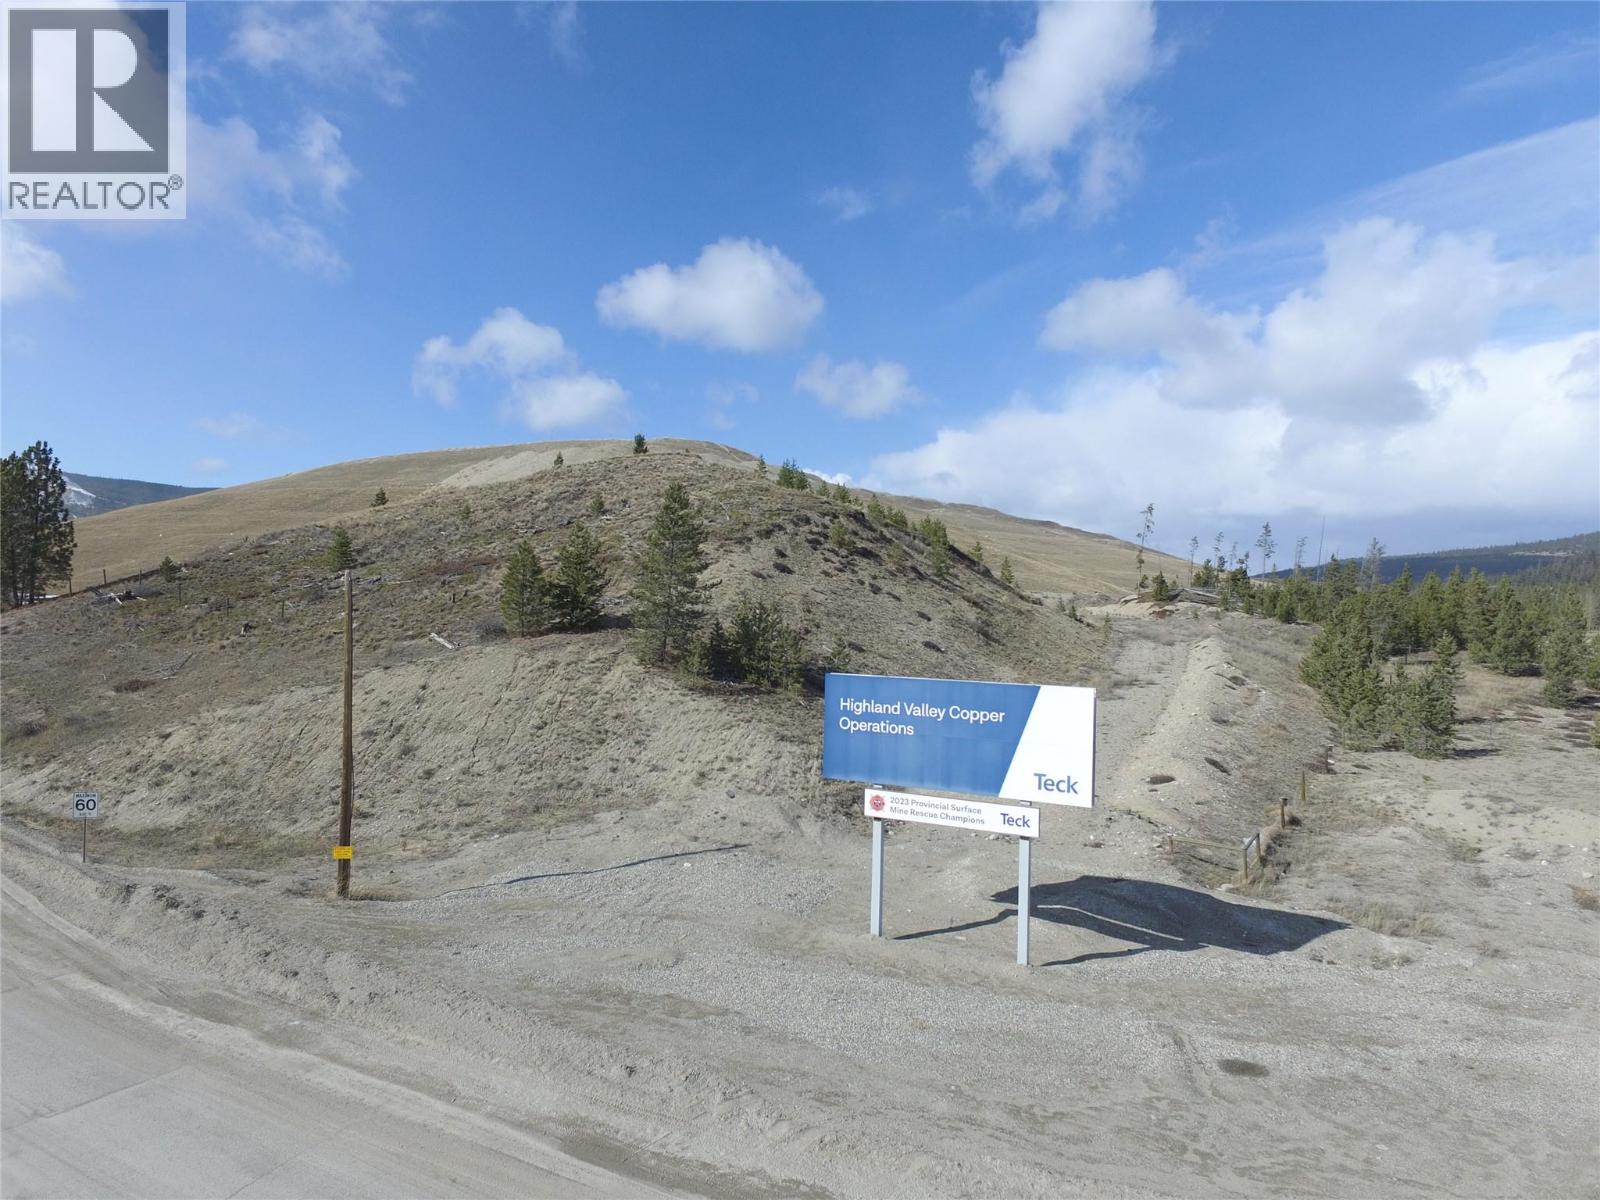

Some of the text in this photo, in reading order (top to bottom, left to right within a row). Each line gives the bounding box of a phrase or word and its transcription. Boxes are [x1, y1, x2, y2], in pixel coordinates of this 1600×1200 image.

[840, 698, 1005, 724] Highland Valley Copper
[839, 717, 915, 735] Operations
[1033, 772, 1079, 795] Teck
[75, 799, 96, 811] 60
[889, 796, 982, 815] 2023 Provincial Surface
[889, 806, 986, 825] Mine Rescue Champions
[1000, 812, 1031, 829] Teck
